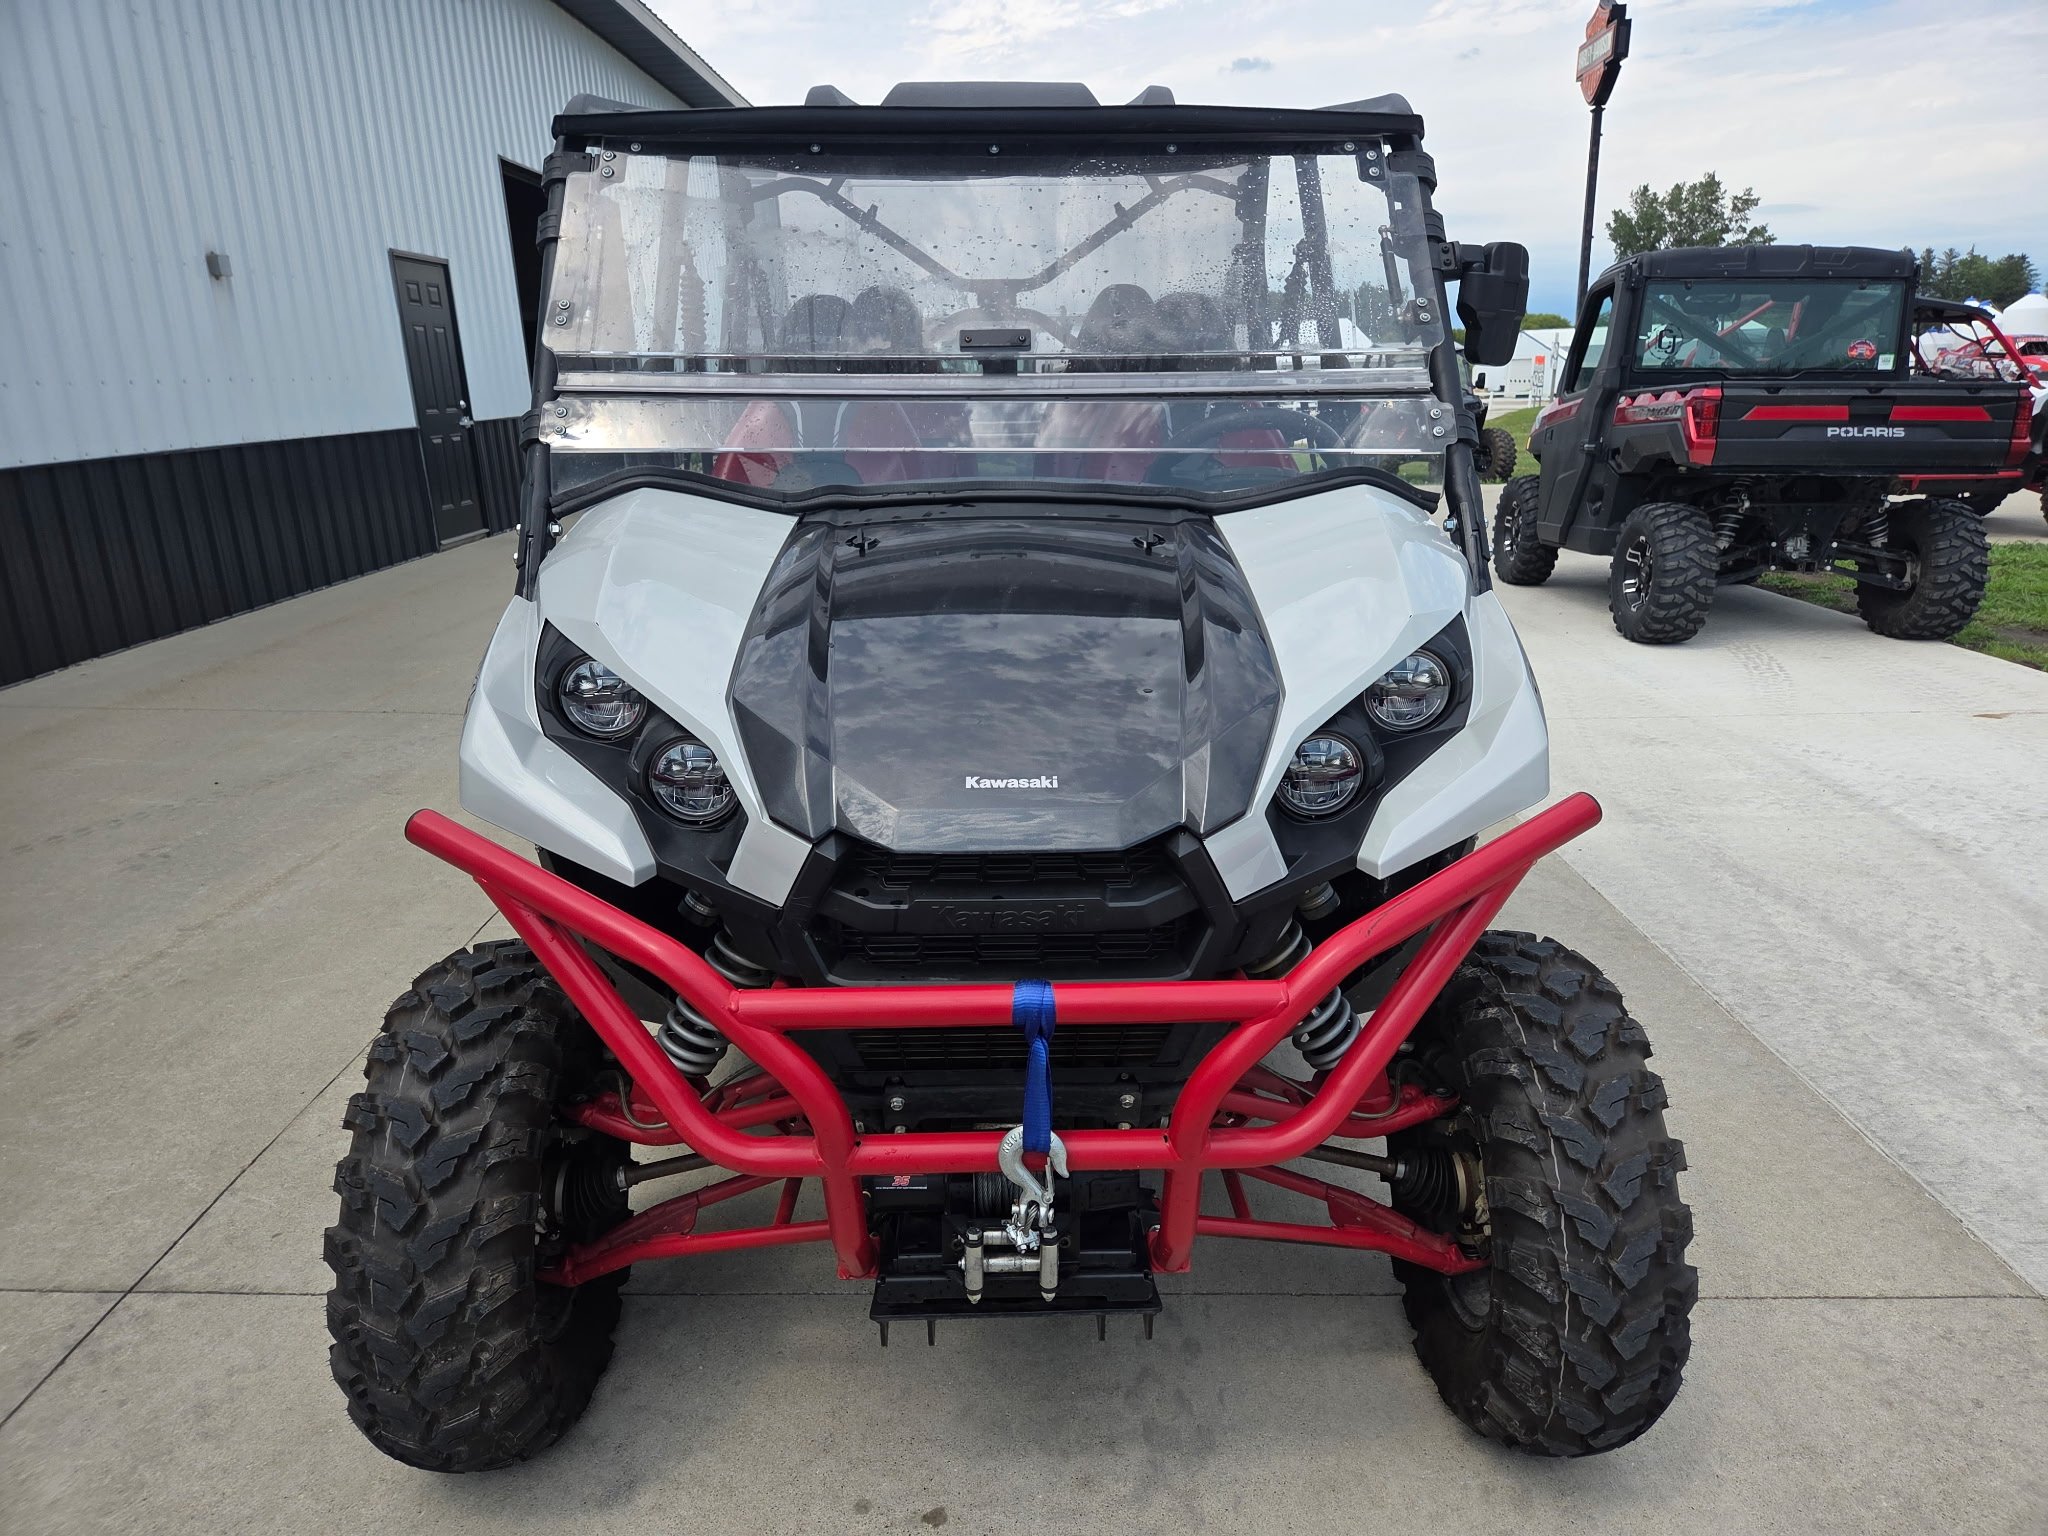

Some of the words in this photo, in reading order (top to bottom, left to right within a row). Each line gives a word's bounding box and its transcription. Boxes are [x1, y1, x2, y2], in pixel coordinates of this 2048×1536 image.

[1827, 426, 1905, 438] POLARIS
[965, 775, 1058, 789] Kawasaki
[931, 904, 1086, 929] Kawasaki
